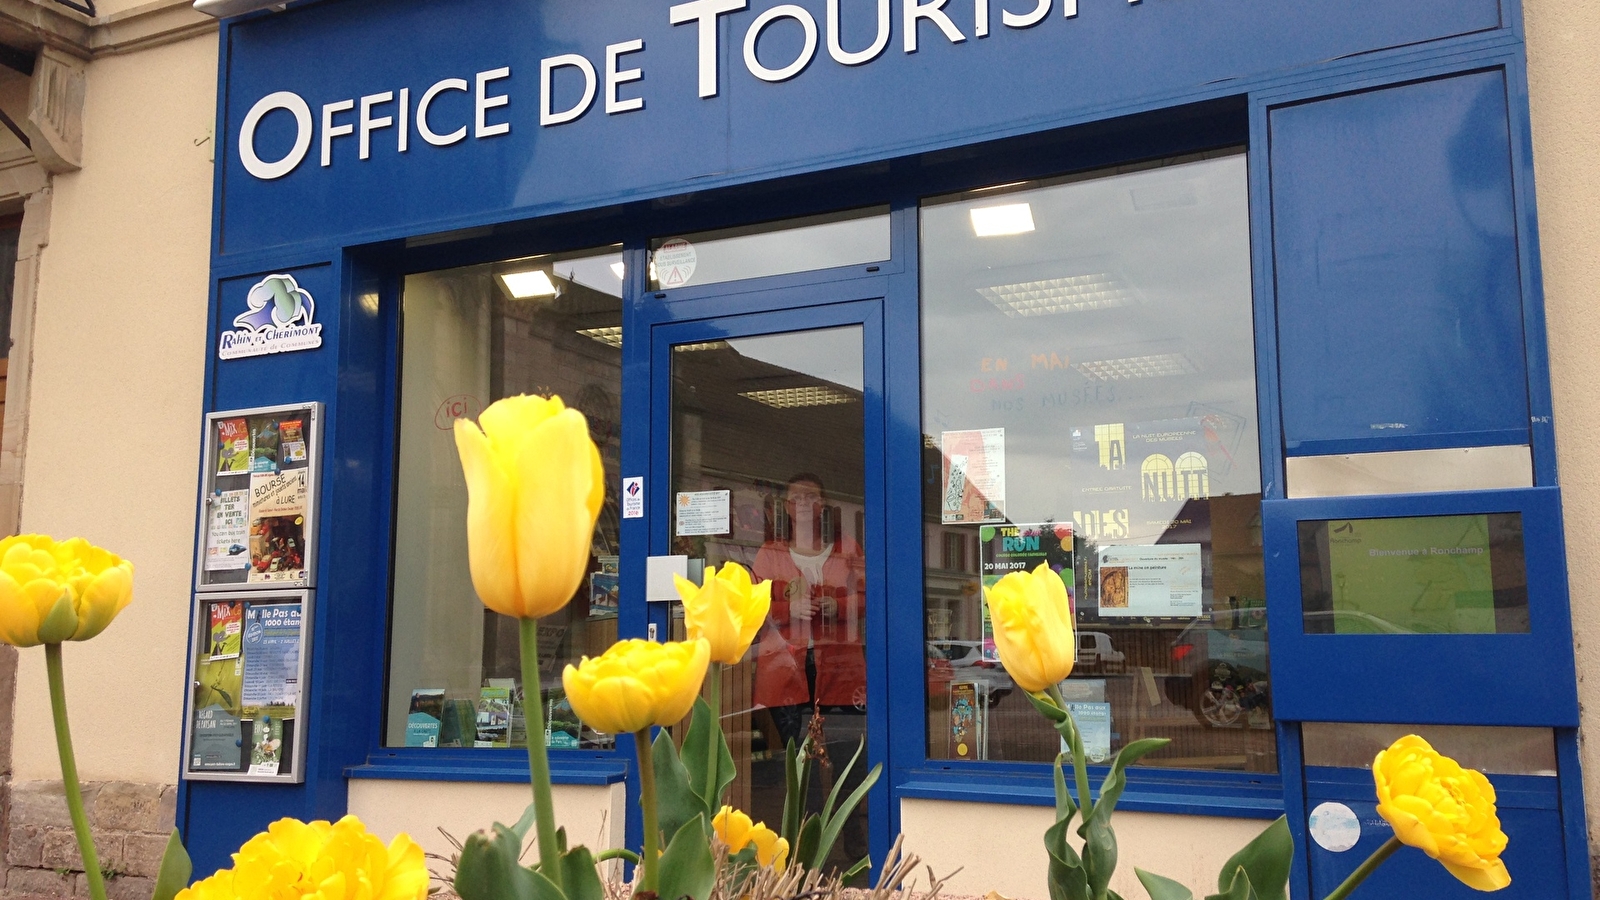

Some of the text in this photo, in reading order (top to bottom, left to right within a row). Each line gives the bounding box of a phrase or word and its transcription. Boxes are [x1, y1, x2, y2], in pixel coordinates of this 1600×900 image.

[239, 0, 1138, 180] OFFICE DE TOURI
[981, 353, 1071, 372] EN MAI
[969, 374, 1026, 393] DANS
[254, 473, 286, 498] BOURSE
[280, 494, 296, 505] LURE
[224, 510, 242, 518] VENTE
[1001, 527, 1020, 537] THE
[1003, 536, 1040, 552] RUN
[1368, 546, 1484, 557] Bienvenue à Ronchamp
[994, 562, 1008, 570] MAI
[1009, 561, 1026, 569] 2017
[272, 608, 289, 618] Pas
[264, 619, 282, 627] 1000
[283, 618, 302, 627] étan
